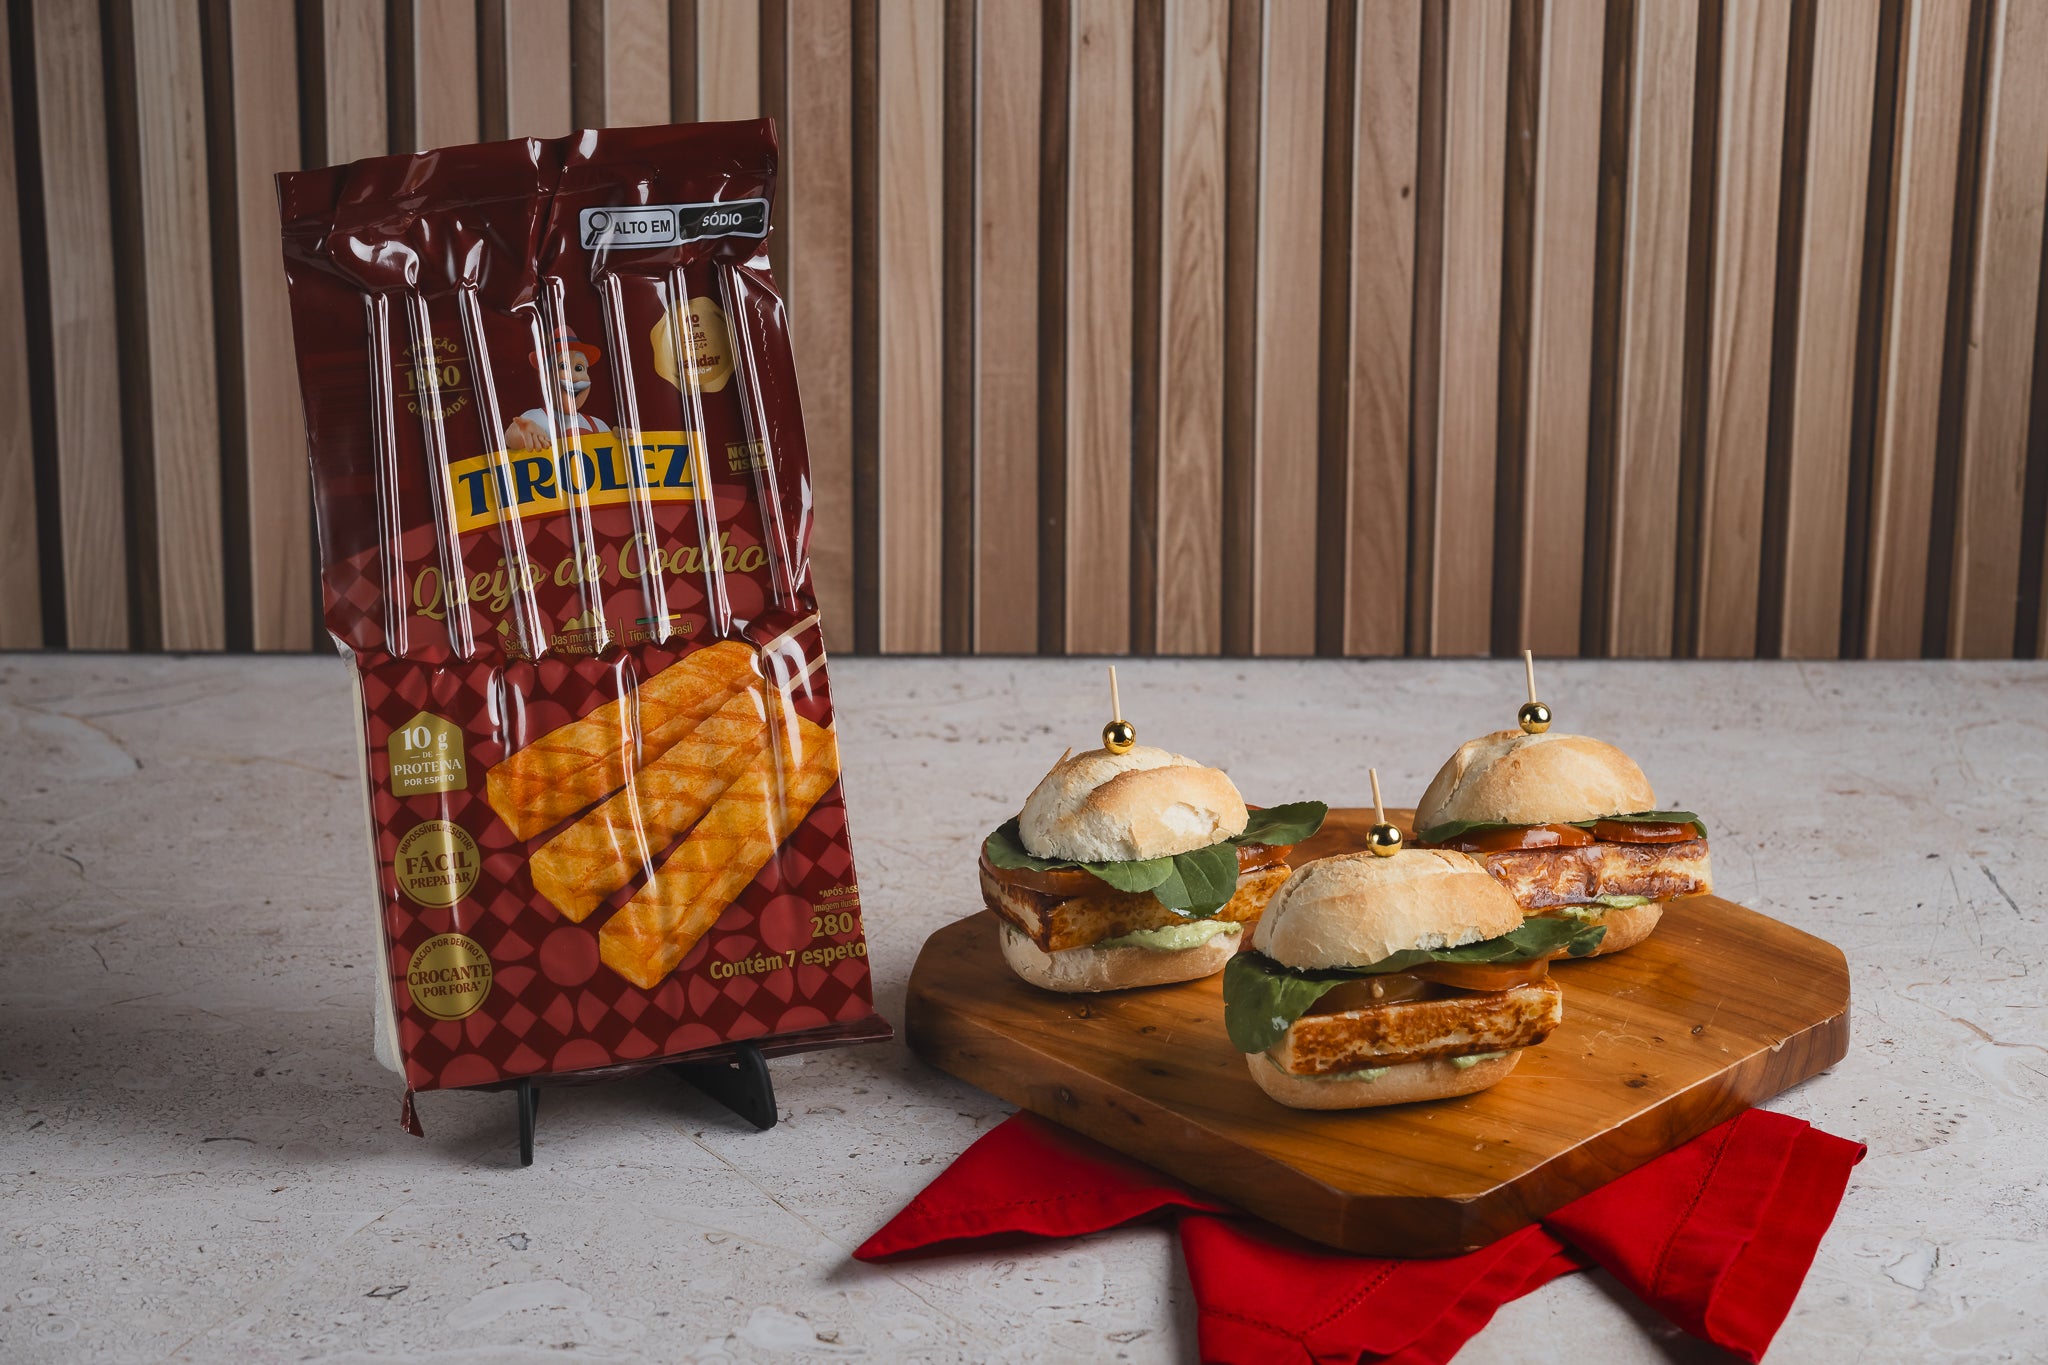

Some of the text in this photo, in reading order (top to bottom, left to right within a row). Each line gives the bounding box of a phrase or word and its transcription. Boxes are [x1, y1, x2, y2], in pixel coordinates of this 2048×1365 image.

[613, 211, 742, 236] ALTO EM SÓDIO
[458, 444, 696, 517] TIROLEZ
[413, 531, 770, 620] Queijo de Coalho
[504, 638, 532, 652] Sabor
[551, 629, 616, 647] Das montaas
[401, 726, 448, 751] 10 g
[422, 751, 433, 759] DE
[404, 774, 455, 787] POR ESPETO
[400, 823, 441, 855] IMPOSSÍVEL
[405, 850, 472, 875] FÁCIL
[409, 872, 471, 889] PREPARAR
[813, 901, 840, 913] Imagem
[810, 912, 854, 938] 280
[431, 937, 449, 950] POR
[450, 937, 480, 957] DENTRO
[476, 953, 484, 961] E
[408, 963, 491, 986] CROCANTE
[709, 951, 783, 980] Contém
[785, 950, 796, 968] 7
[423, 985, 448, 998] POR
